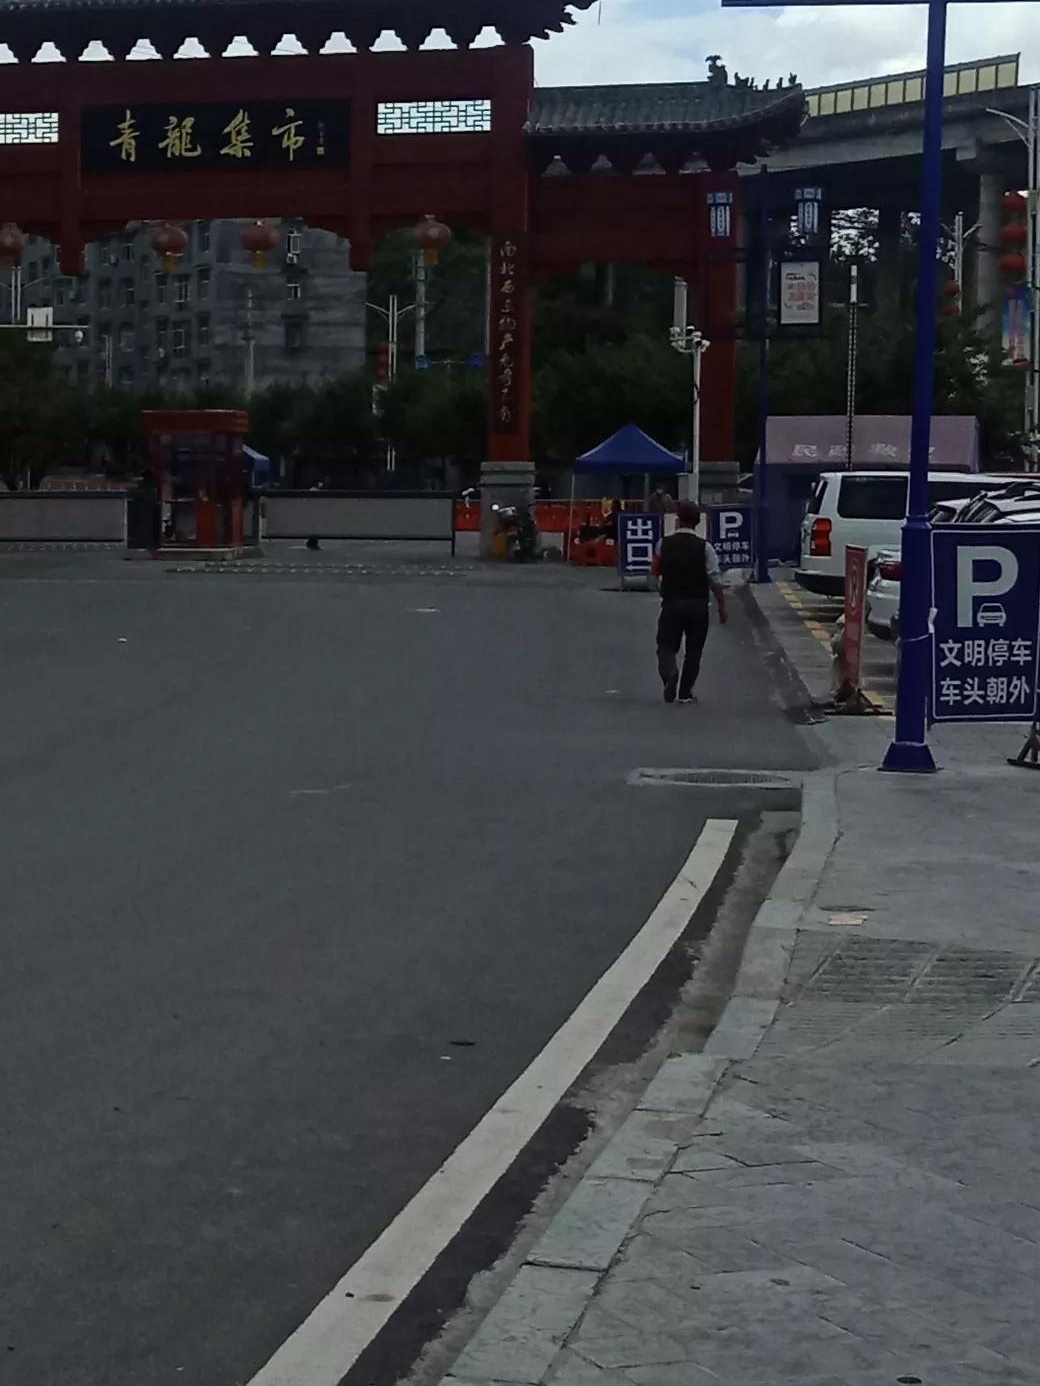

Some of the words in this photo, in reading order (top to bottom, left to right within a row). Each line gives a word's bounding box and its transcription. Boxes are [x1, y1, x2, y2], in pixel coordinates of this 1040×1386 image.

[625, 517, 654, 563] 出口
[719, 511, 744, 540] P
[956, 545, 1019, 629] P
[939, 638, 1033, 667] 文明停车
[939, 675, 1030, 706] 车头朝外
